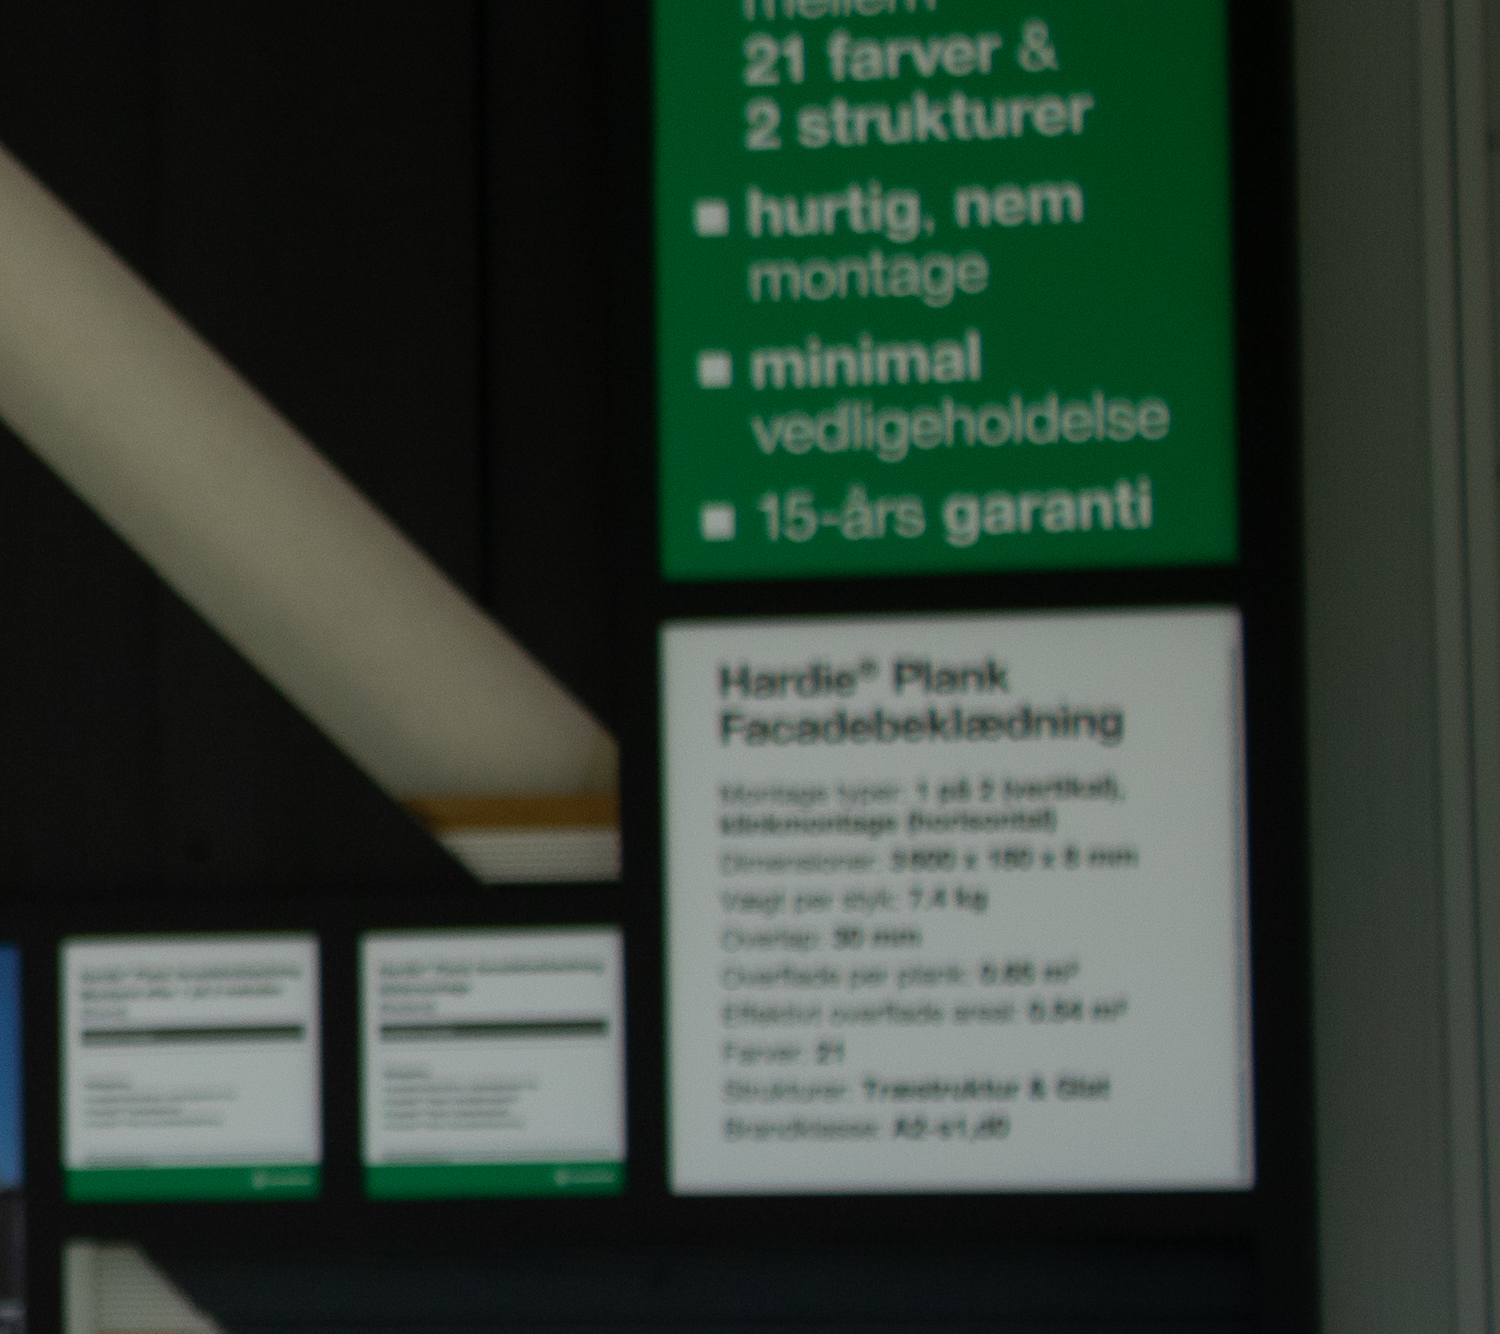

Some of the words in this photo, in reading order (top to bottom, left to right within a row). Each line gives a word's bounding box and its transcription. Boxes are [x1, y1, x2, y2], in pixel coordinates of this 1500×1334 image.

[742, 31, 806, 87] 21
[827, 28, 1003, 83] farver
[1017, 18, 1060, 73] &
[743, 96, 782, 152] 2
[797, 88, 1096, 149] strukturer
[745, 179, 936, 244] hurtig,
[952, 180, 1086, 227] nem
[747, 249, 991, 308] montage
[749, 327, 984, 390] minimal
[750, 389, 1172, 464] vedligeholdelse
[755, 482, 928, 543] 15-års
[942, 475, 1155, 549] garanti
[891, 657, 1010, 698] Plank
[717, 704, 1127, 748] Facadebeklædning
